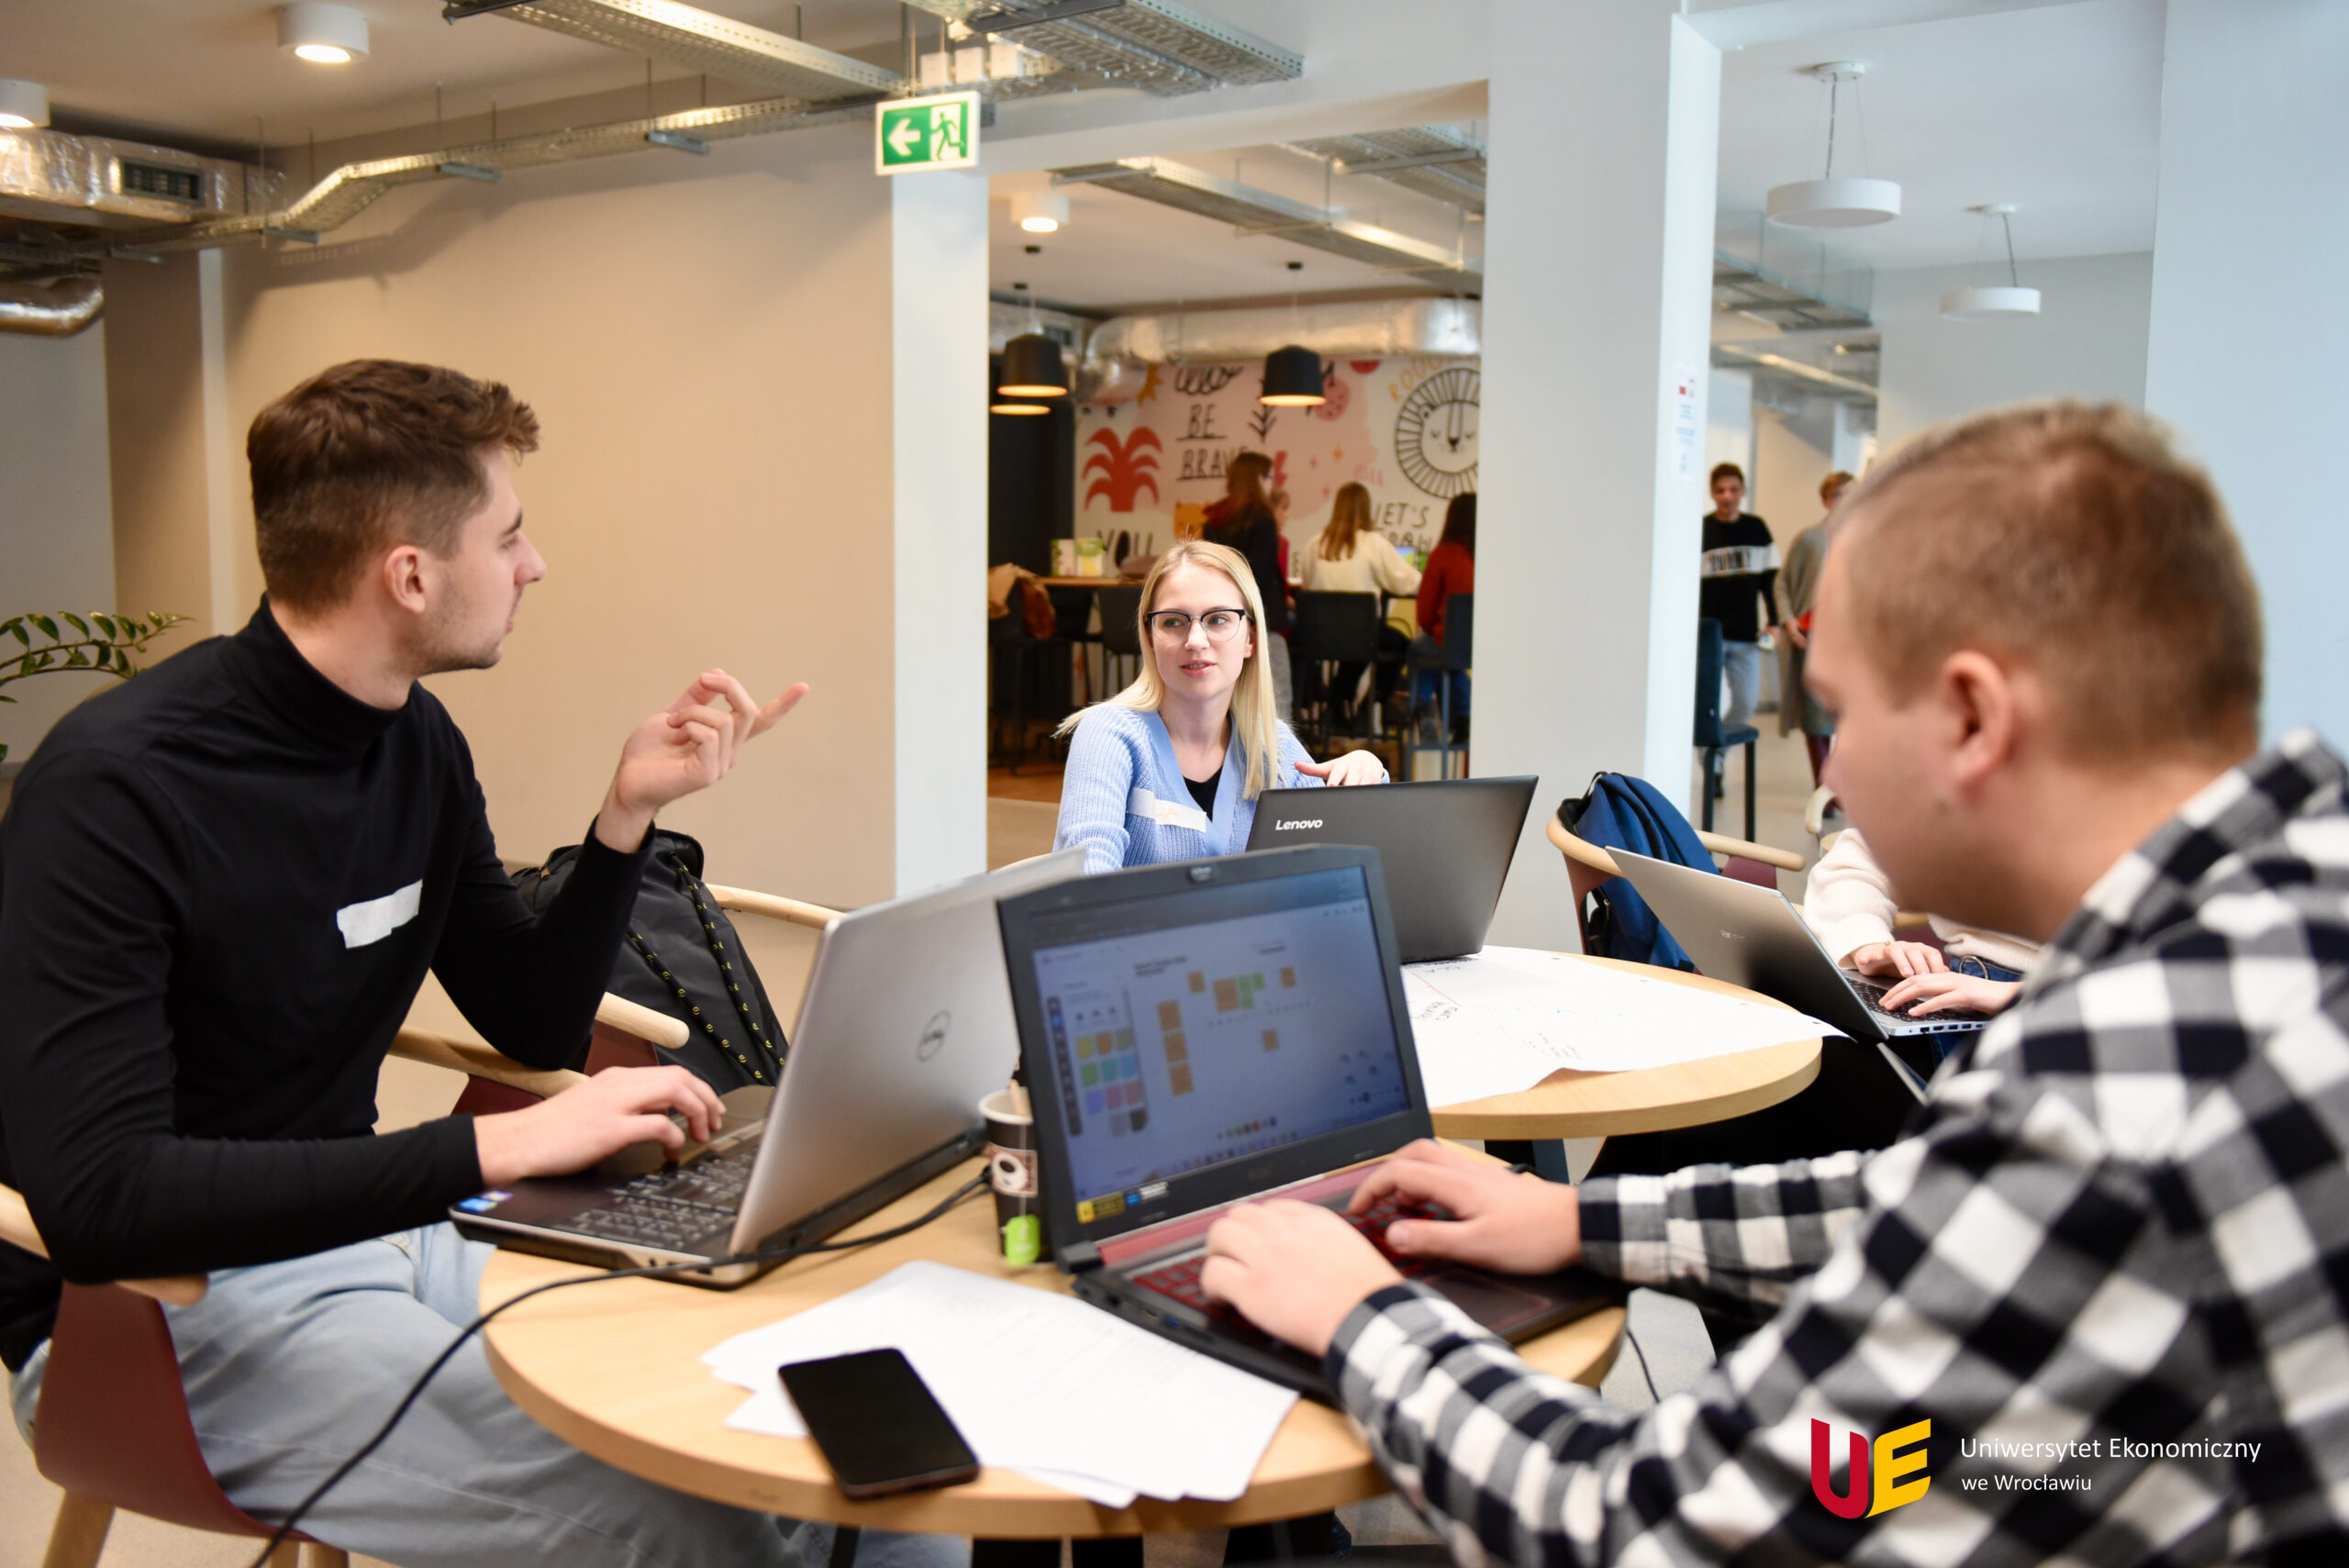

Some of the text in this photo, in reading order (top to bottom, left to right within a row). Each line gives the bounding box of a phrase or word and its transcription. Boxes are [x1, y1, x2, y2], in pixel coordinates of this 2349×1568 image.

[1186, 404, 1218, 439] BE
[1179, 446, 1248, 478] BRAV
[1275, 818, 1323, 831] Lenovo
